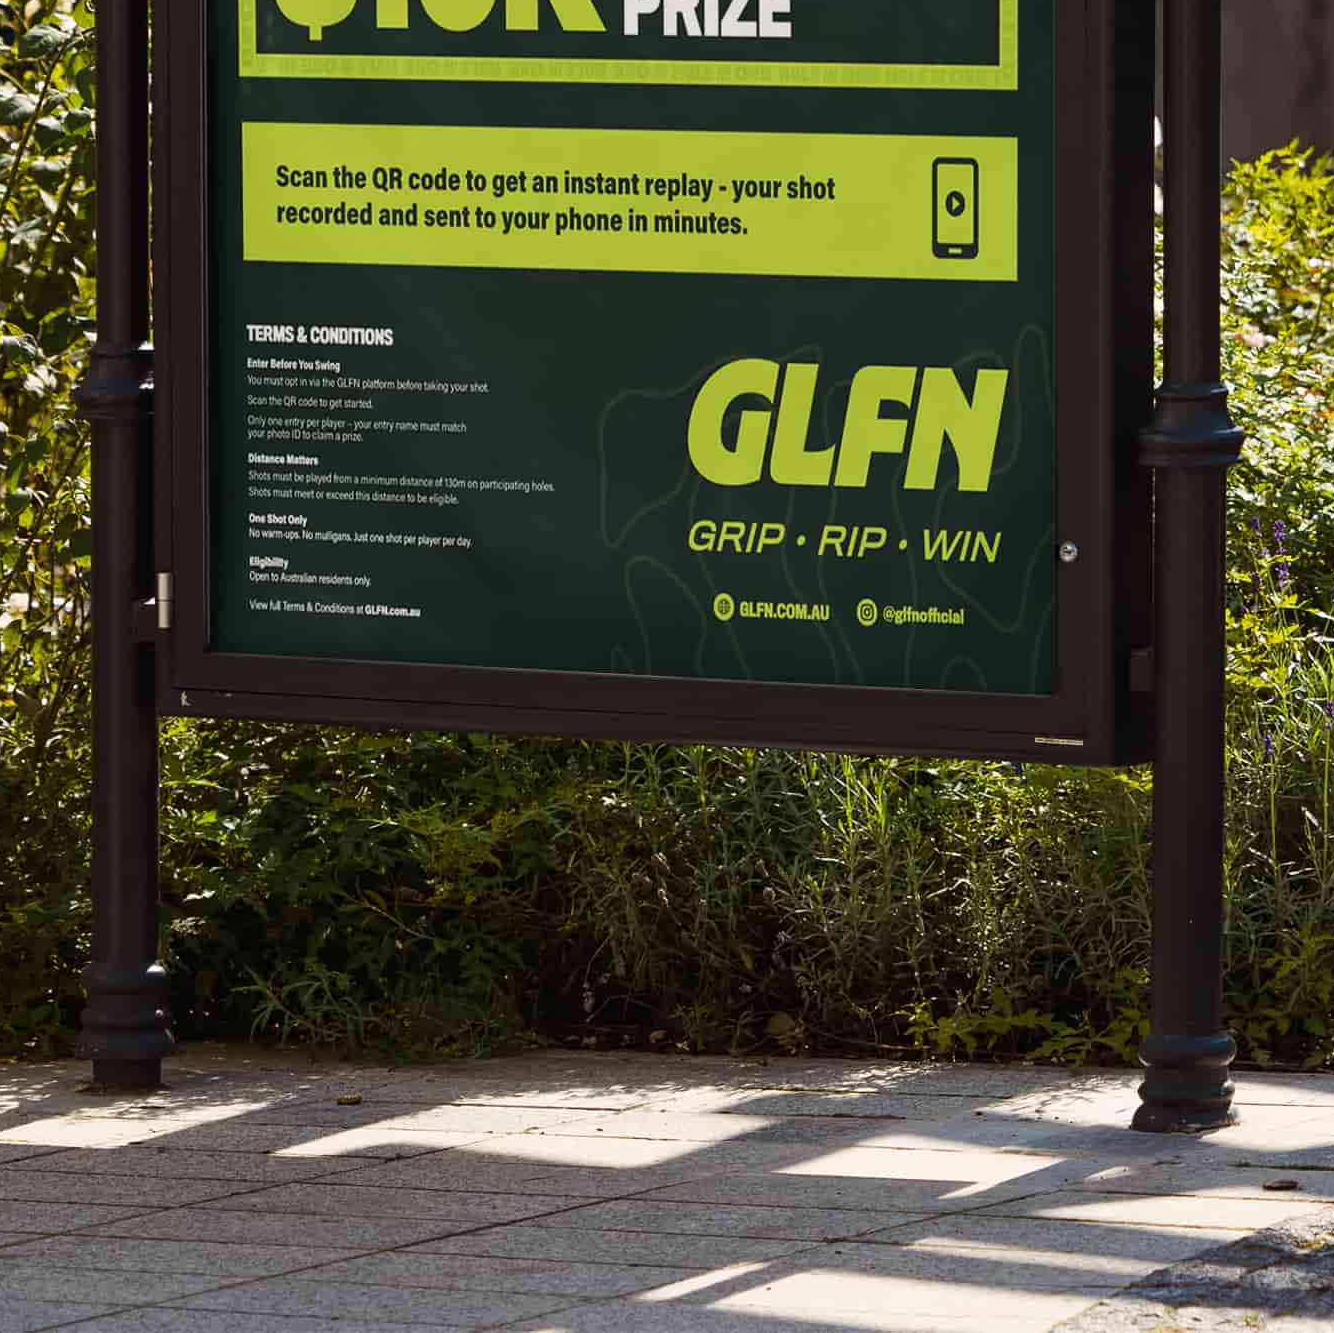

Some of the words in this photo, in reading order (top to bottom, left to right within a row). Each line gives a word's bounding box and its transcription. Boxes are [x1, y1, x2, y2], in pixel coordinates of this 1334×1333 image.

[276, 165, 327, 188] Scan
[333, 165, 366, 188] the
[372, 167, 403, 191] QR
[408, 168, 460, 190] code
[465, 170, 487, 191] to
[492, 171, 527, 197] get
[532, 175, 558, 193] an
[564, 171, 639, 195] instant
[644, 173, 714, 201] replay
[732, 178, 782, 203] your
[786, 175, 836, 200] shot
[277, 202, 373, 224] recorded
[378, 203, 418, 226] and
[424, 207, 470, 227] sent
[475, 207, 496, 228] to
[501, 209, 550, 234] your
[555, 207, 623, 235] phone
[628, 209, 648, 232] in
[654, 210, 748, 235] minutes.
[247, 324, 295, 342] TERMS
[297, 326, 308, 343] &
[310, 326, 394, 346] CONDITIONS
[247, 357, 268, 368] Enter
[270, 358, 297, 369] Before
[299, 359, 313, 370] You
[315, 359, 341, 373] Swing
[247, 375, 262, 385] You
[264, 376, 284, 386] must
[285, 377, 298, 388] opt
[299, 377, 307, 387] in
[309, 377, 321, 387] via
[322, 377, 335, 387] the
[336, 377, 361, 388] GLFN
[362, 378, 395, 389] platform
[397, 379, 422, 390] before
[424, 380, 448, 393] taking
[450, 383, 468, 394] your
[470, 382, 490, 392] shot.
[247, 395, 267, 405] Scan
[269, 395, 282, 405] the
[283, 396, 296, 407] QR
[298, 396, 318, 407] code
[319, 398, 327, 407] to
[329, 398, 342, 410] get
[344, 399, 373, 409] started.
[687, 358, 1010, 492] GLFN
[248, 452, 285, 464] Distance
[287, 454, 318, 466] Matters
[249, 512, 266, 524] One
[267, 513, 286, 524] Shot
[288, 514, 307, 527] Only
[249, 528, 260, 539] No
[261, 529, 300, 543] warm-ups.
[302, 530, 313, 540] No
[314, 530, 351, 543] mulligans.
[353, 532, 368, 543] Just
[369, 534, 384, 543] one
[386, 533, 402, 544] shot
[403, 535, 417, 546] per
[418, 534, 441, 547] player
[442, 537, 455, 547] per
[456, 536, 474, 550] day.
[688, 520, 786, 553] GRIP
[818, 525, 888, 558] RIP
[922, 529, 1002, 563] WIN
[249, 556, 289, 569] Eligibility
[249, 571, 269, 584] Open
[270, 572, 279, 582] to
[280, 572, 317, 584] Australian
[319, 573, 353, 586] residents
[354, 575, 371, 588] only.
[249, 599, 268, 610] View
[269, 599, 281, 611] full
[282, 600, 305, 612] Terms
[306, 601, 314, 612] &
[315, 602, 355, 614] Conditions
[356, 604, 364, 614] at
[365, 605, 421, 617] GLFN.com.au
[740, 601, 830, 621] GLFN.COM.AU
[883, 606, 965, 625] @glfnofficial
